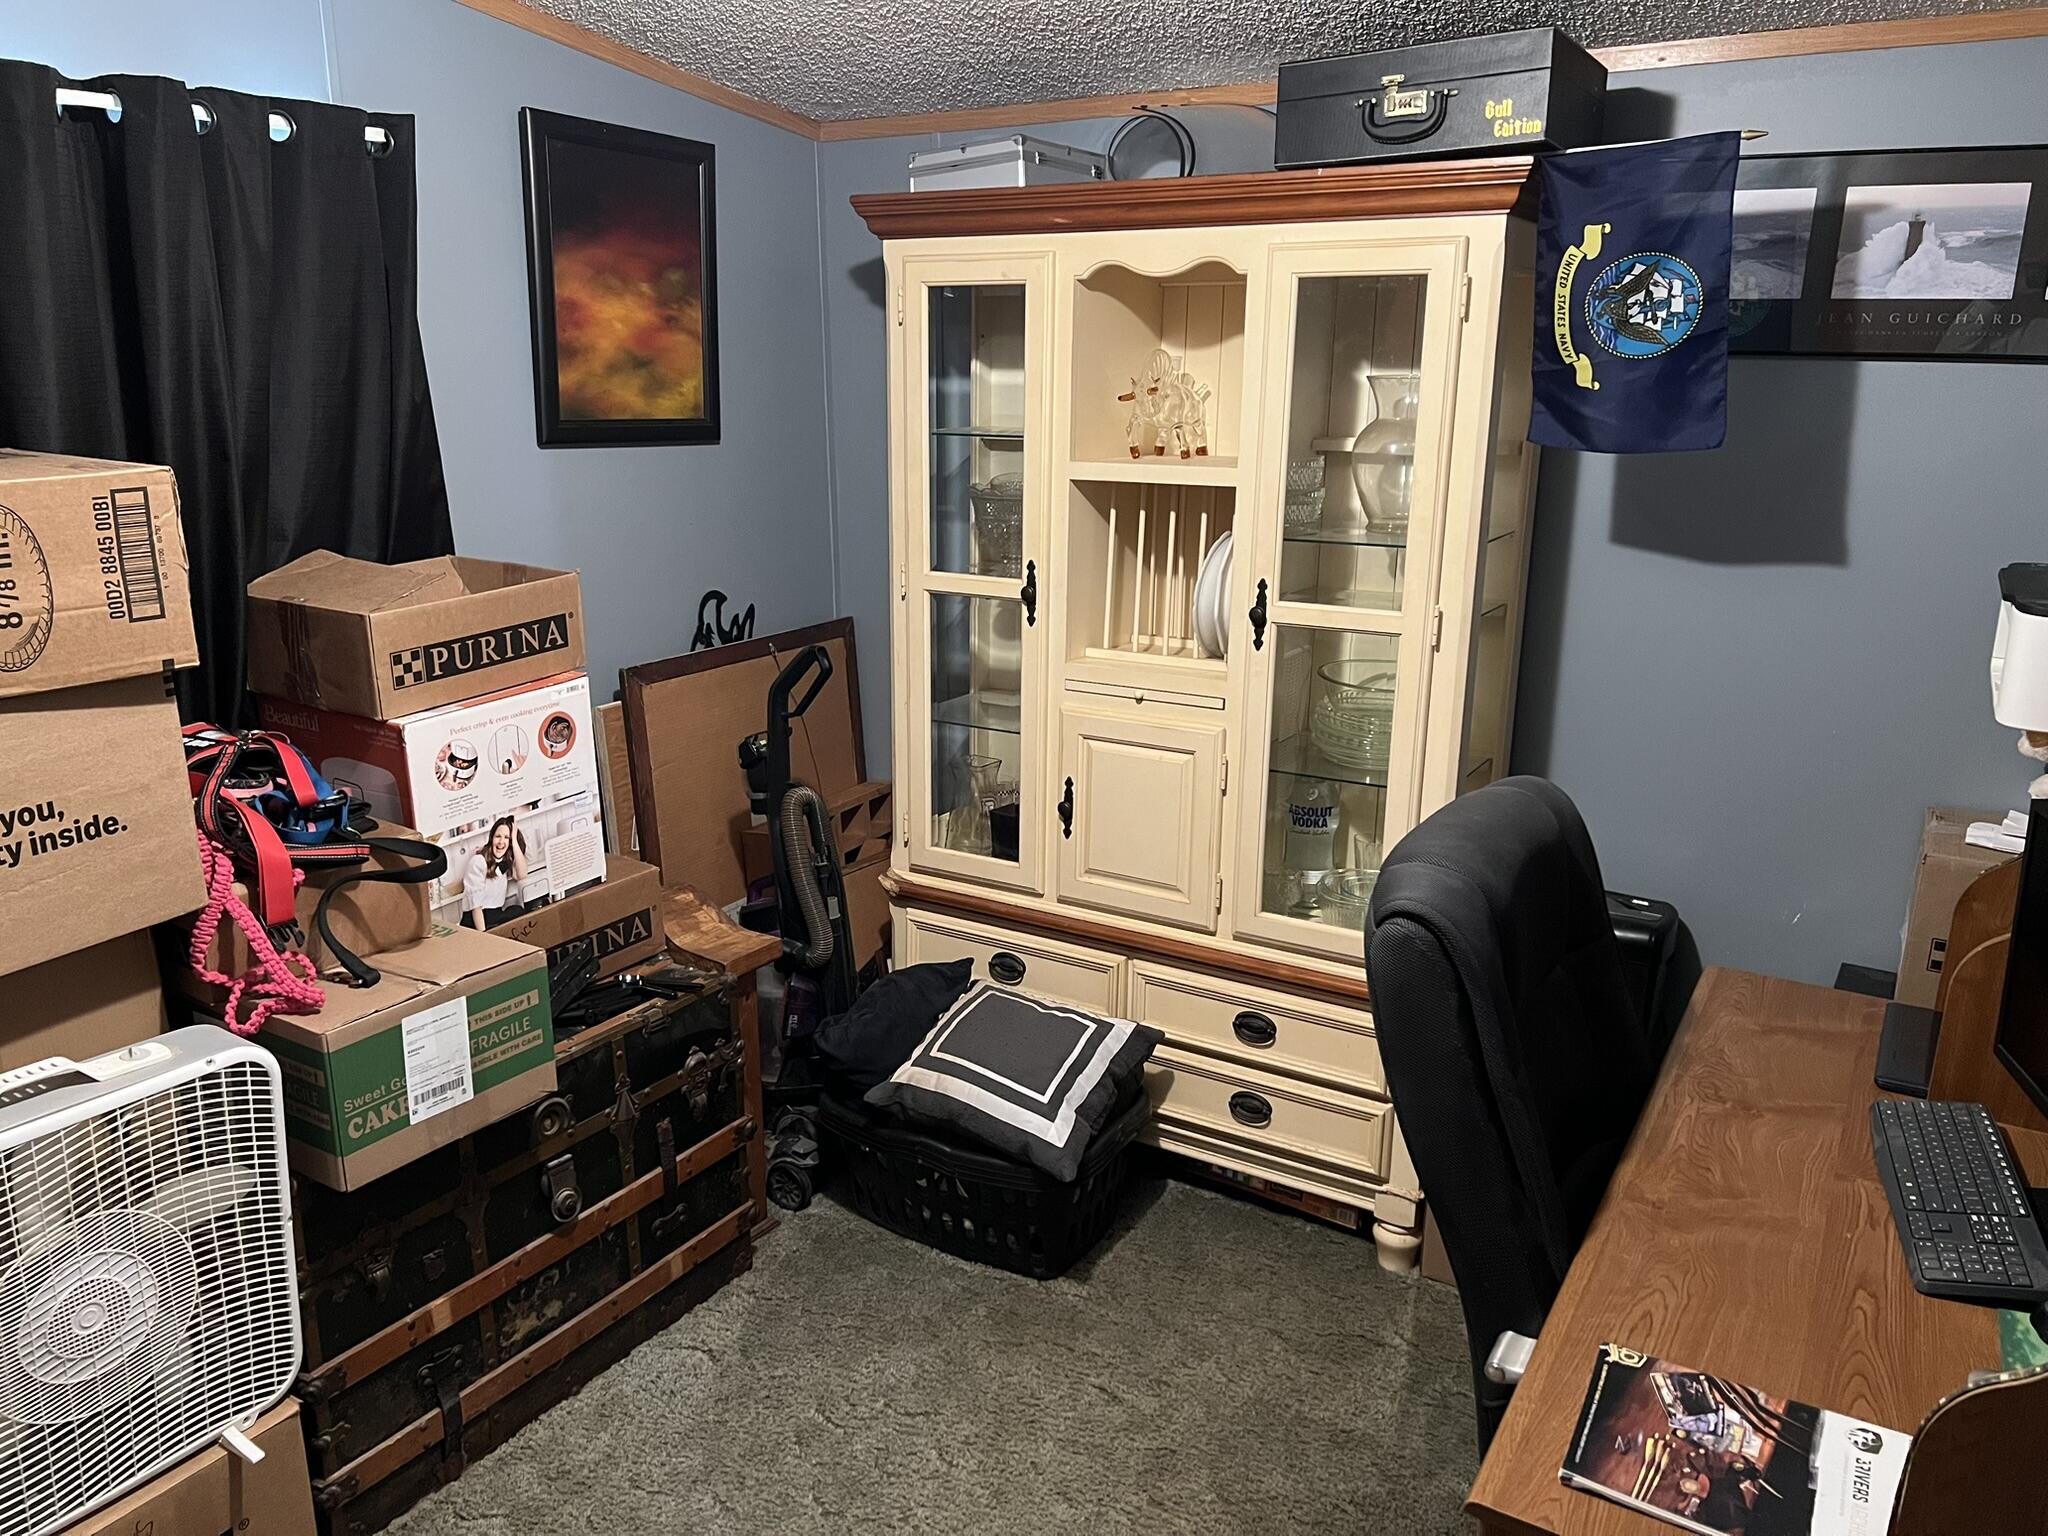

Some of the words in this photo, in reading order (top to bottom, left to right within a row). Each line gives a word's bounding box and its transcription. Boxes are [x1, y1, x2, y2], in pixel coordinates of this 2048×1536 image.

[1559, 253, 1578, 289] UNITED
[1557, 293, 1567, 328] STATES
[1889, 311, 2023, 325] GUICHARD
[1558, 333, 1574, 359] NAVY
[97, 536, 118, 574] 8845
[104, 579, 126, 620] 00D2
[430, 620, 565, 676] PURINA
[263, 703, 320, 731] Beautiful
[449, 724, 472, 737] Perfect
[472, 720, 488, 731] crisp
[495, 714, 510, 724] even
[510, 708, 533, 720] cooking
[0, 801, 65, 838] you,
[1289, 803, 1334, 817] ABSOLUT
[1292, 815, 1328, 828] VODKA
[28, 814, 128, 856] inside.
[474, 1012, 493, 1025] THIS
[494, 1004, 512, 1017] SIDE
[514, 999, 524, 1009] UP
[471, 1016, 531, 1054] FRAGILE
[472, 1053, 498, 1068] ANDLE
[500, 1043, 520, 1055] WITH
[521, 1034, 541, 1047] CARE
[344, 1084, 386, 1112] Sweet
